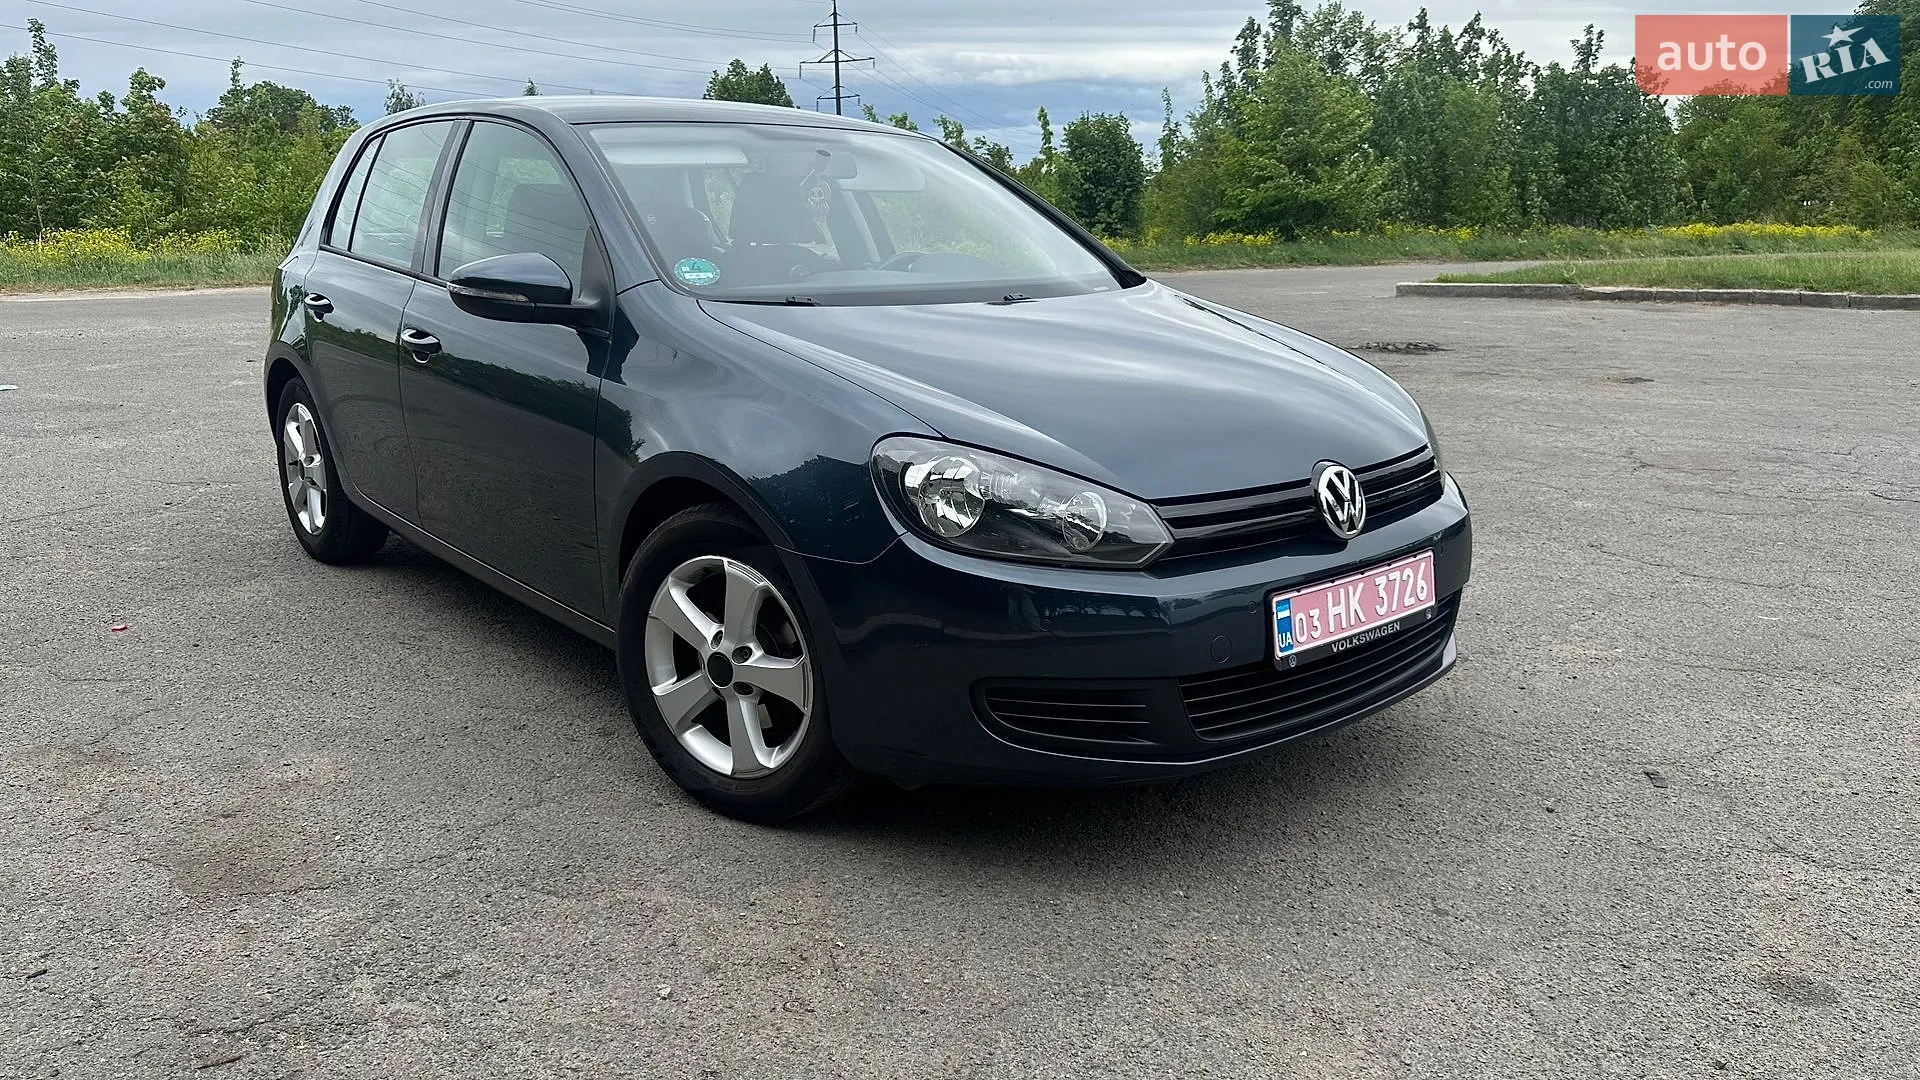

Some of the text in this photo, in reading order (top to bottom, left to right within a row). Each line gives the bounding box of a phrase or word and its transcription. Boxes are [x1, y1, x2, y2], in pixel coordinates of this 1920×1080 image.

[1295, 562, 1428, 643] 03 HK 3726
[1278, 632, 1294, 649] UA
[1331, 621, 1401, 653] VOLKSWAGEN
